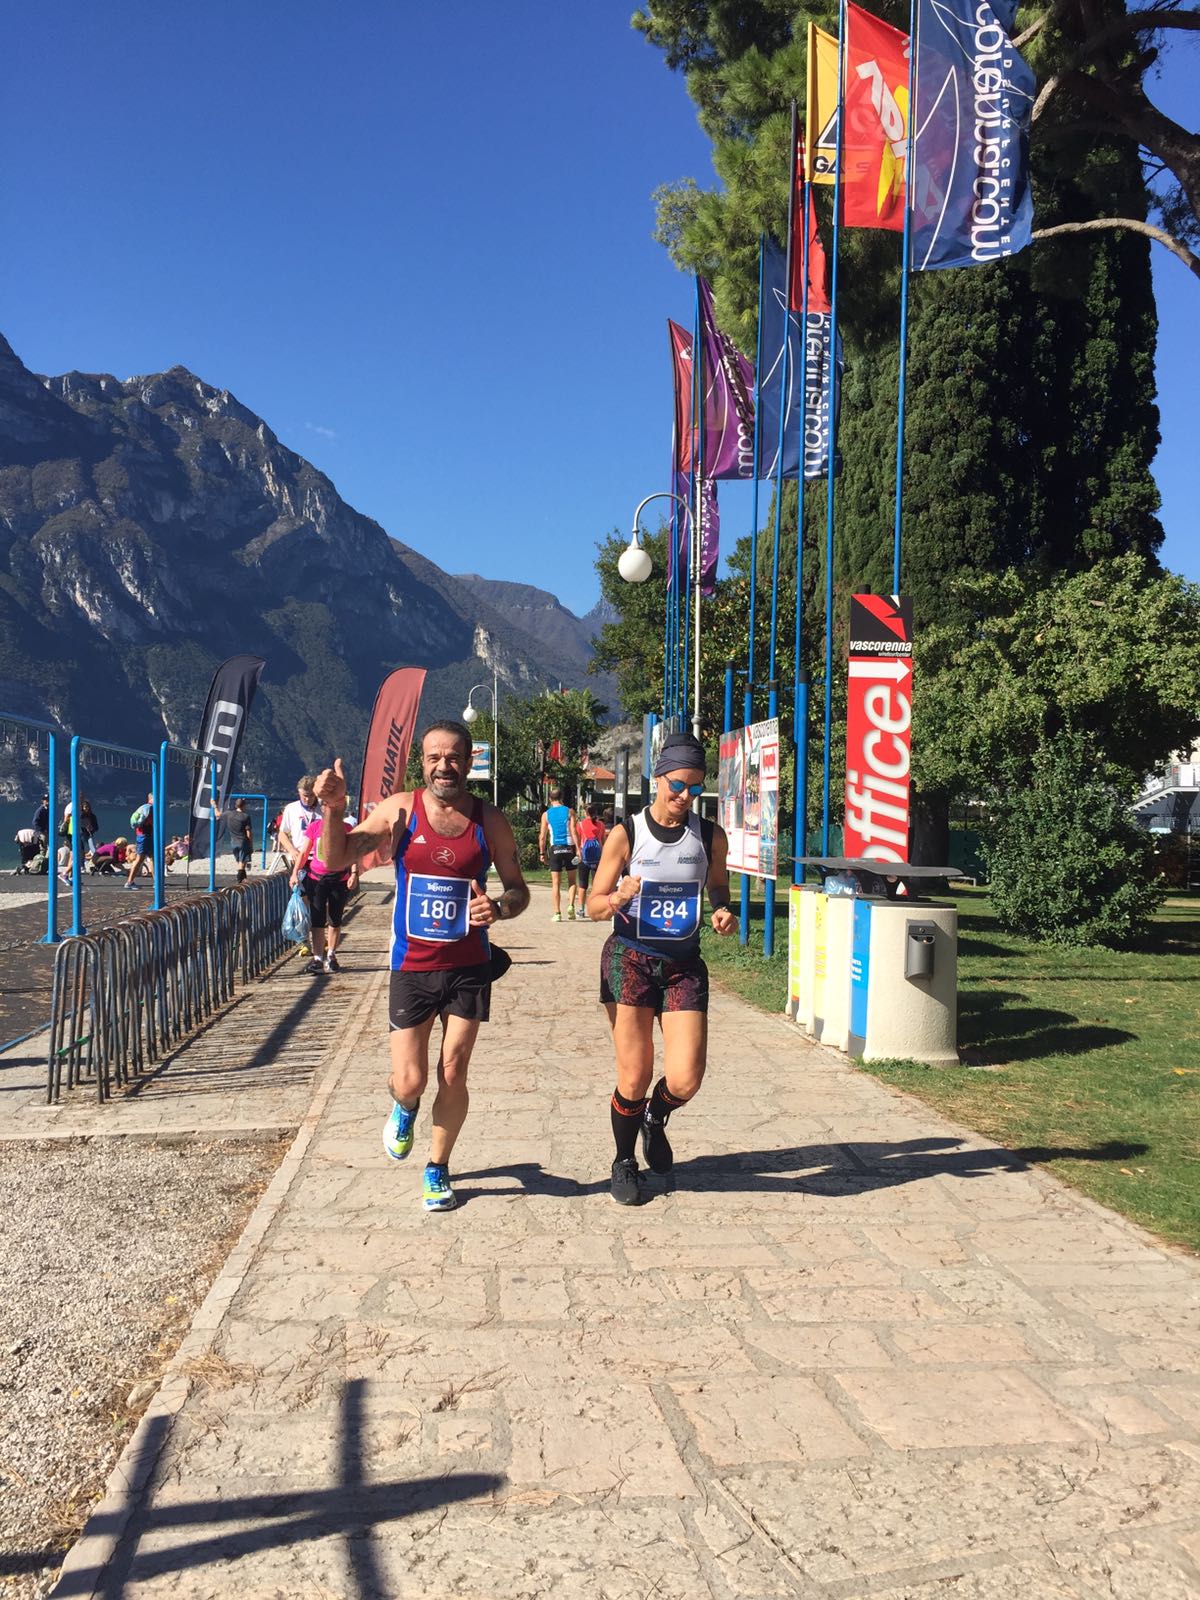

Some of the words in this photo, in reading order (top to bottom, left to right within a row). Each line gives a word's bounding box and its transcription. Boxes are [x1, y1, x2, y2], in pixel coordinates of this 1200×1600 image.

[850, 640, 912, 652] vascorenna
[379, 717, 403, 800] FANATIC
[419, 898, 457, 920] 180
[650, 899, 689, 919] 284
